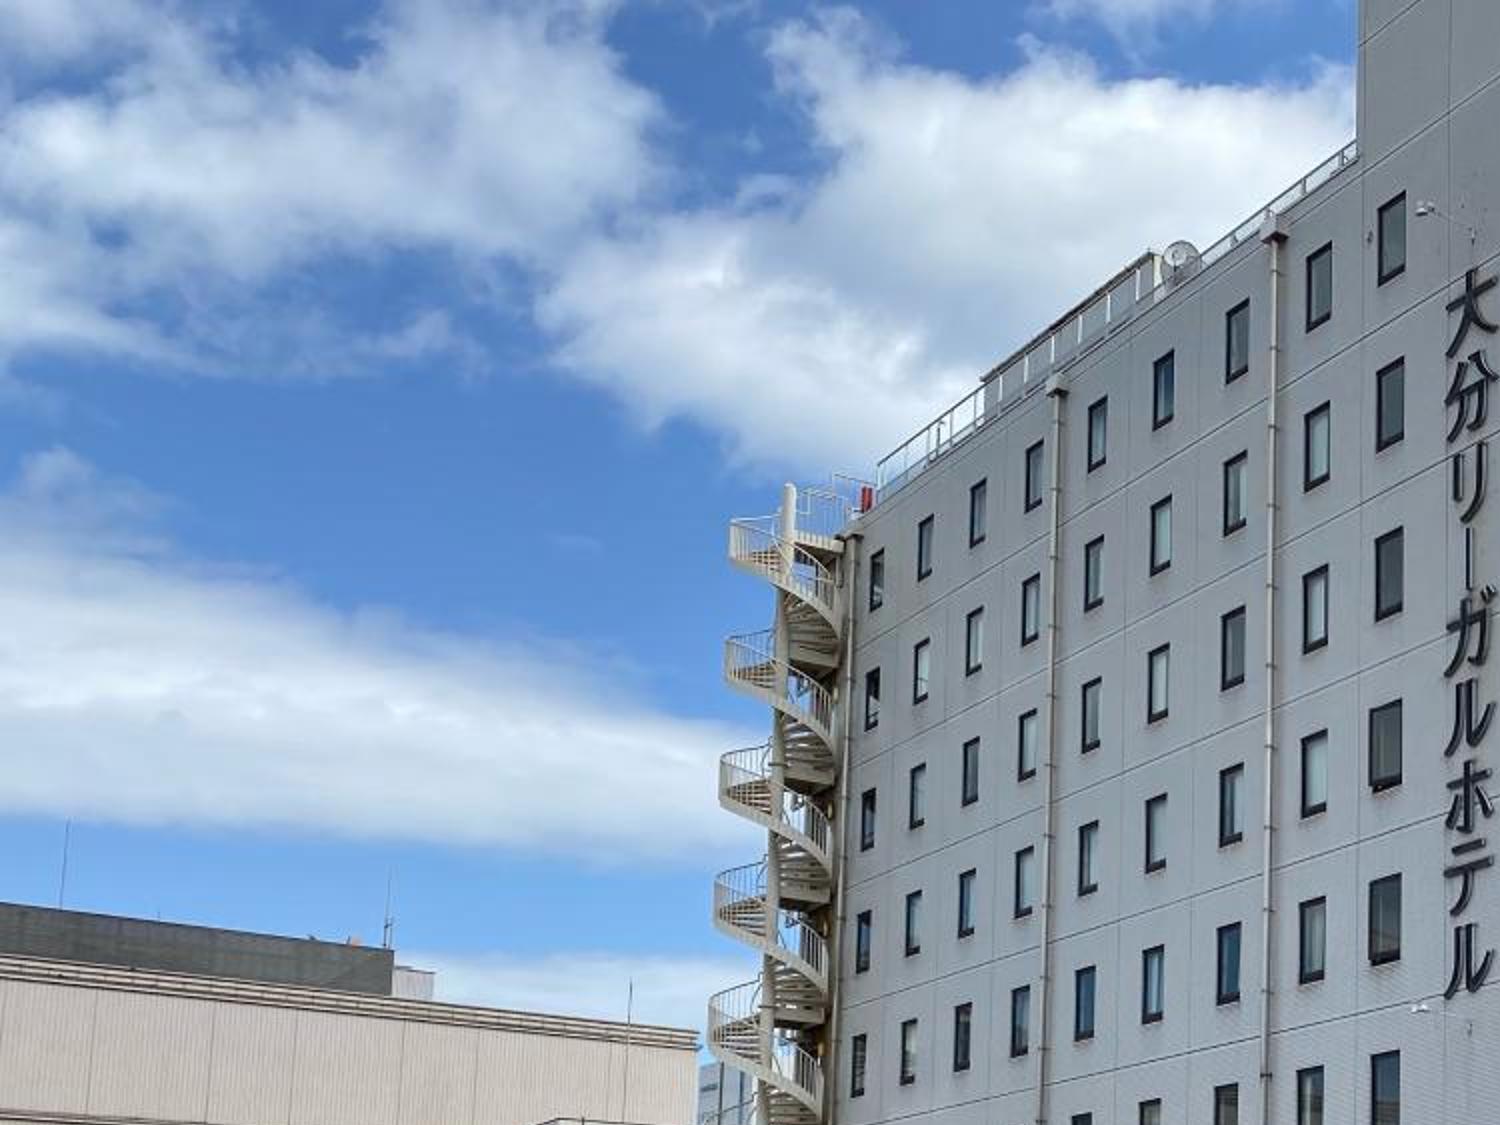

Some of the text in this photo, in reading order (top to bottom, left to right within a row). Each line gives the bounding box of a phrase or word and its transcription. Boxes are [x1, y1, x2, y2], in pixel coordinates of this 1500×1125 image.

[1444, 267, 1499, 1000] 大分リーガルホテル
